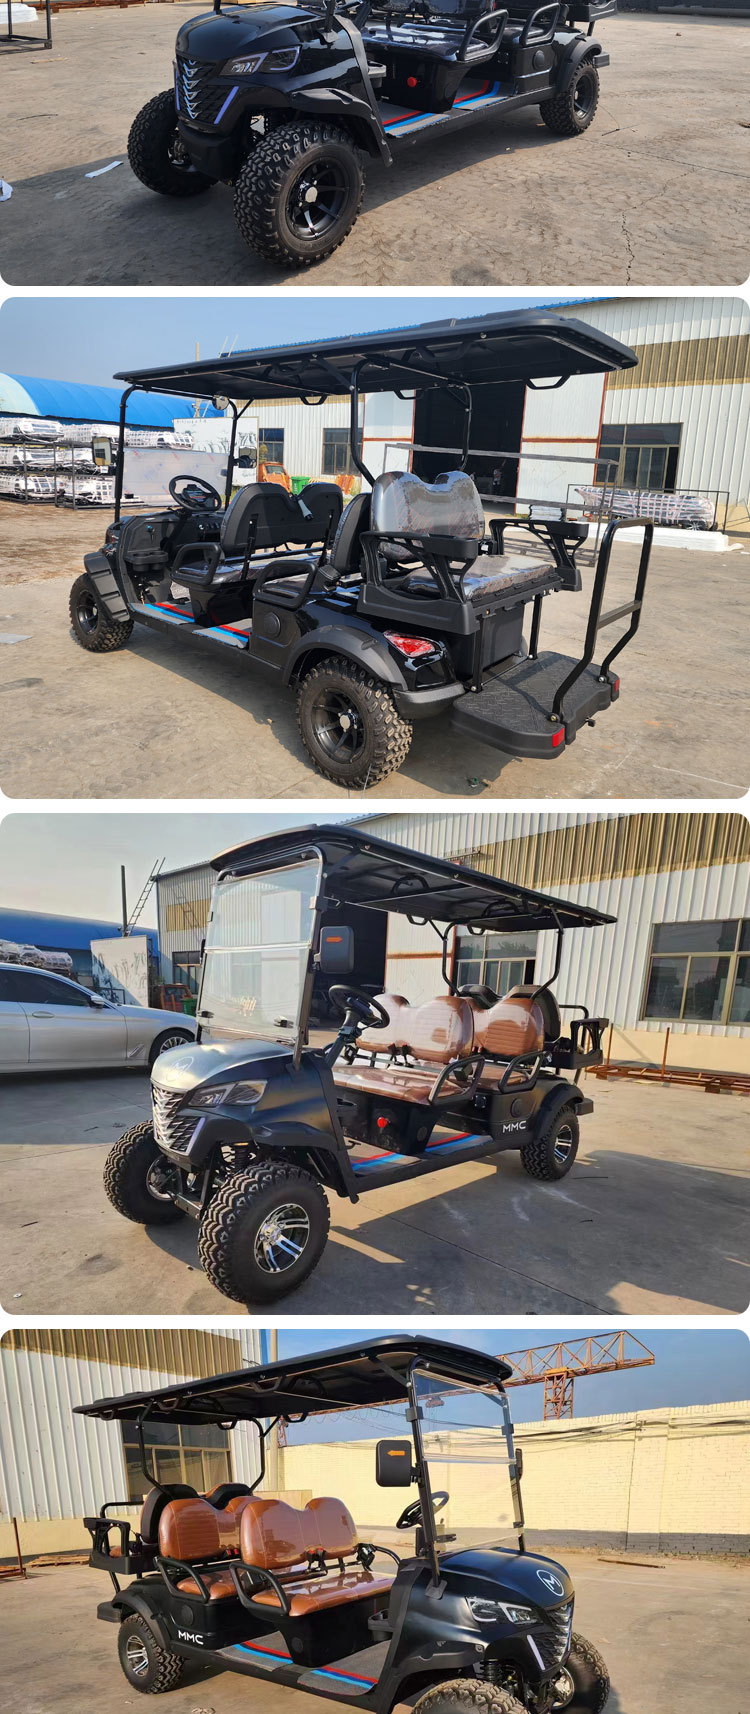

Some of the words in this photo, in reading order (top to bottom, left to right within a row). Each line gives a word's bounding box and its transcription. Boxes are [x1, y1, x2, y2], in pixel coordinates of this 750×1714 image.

[502, 1120, 527, 1133] MMC
[542, 1575, 561, 1591] M
[178, 1630, 204, 1645] MMC
